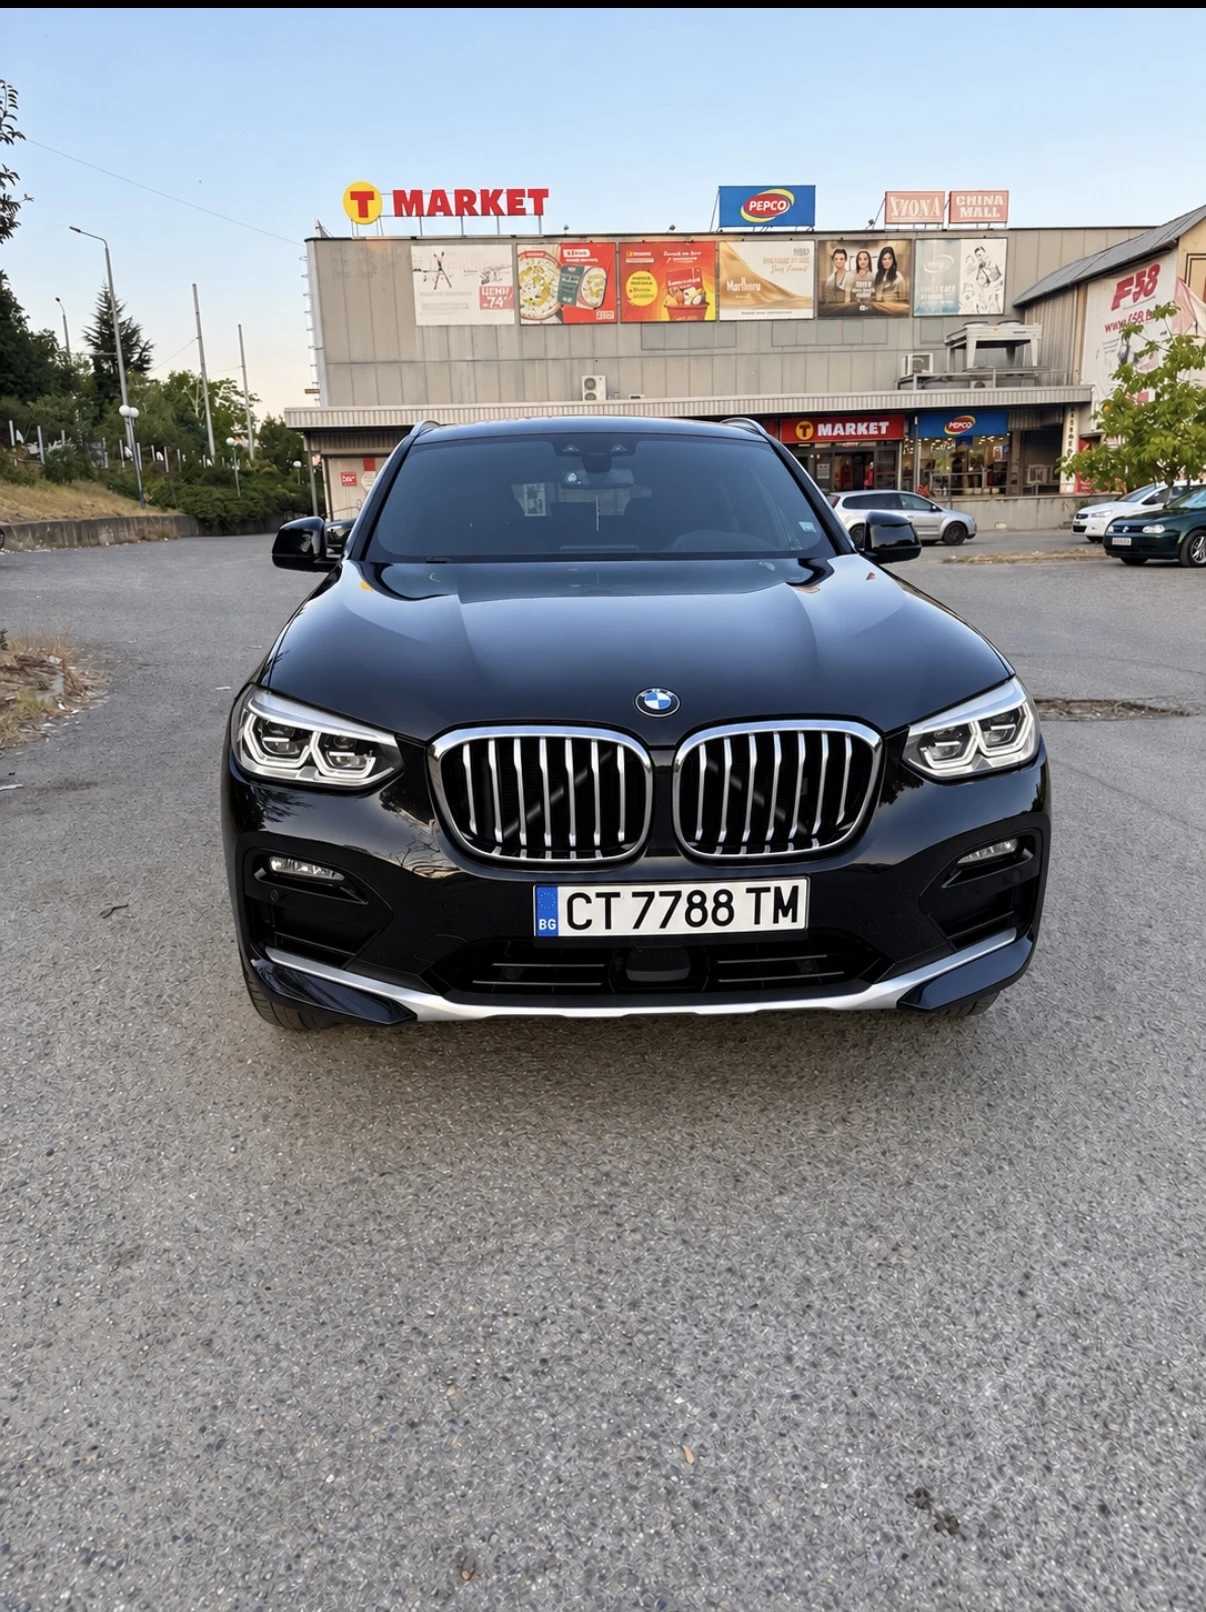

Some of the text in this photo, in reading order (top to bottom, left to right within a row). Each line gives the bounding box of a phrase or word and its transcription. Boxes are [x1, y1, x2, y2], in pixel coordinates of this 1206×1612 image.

[350, 188, 550, 218] T MARKET
[748, 199, 788, 212] PEPCO
[955, 195, 1005, 206] CHINA
[960, 206, 1001, 218] MALL
[1111, 263, 1161, 311] F58
[798, 421, 889, 438] T MARKET
[566, 884, 800, 931] CT 7788 TM
[538, 918, 557, 931] BG
